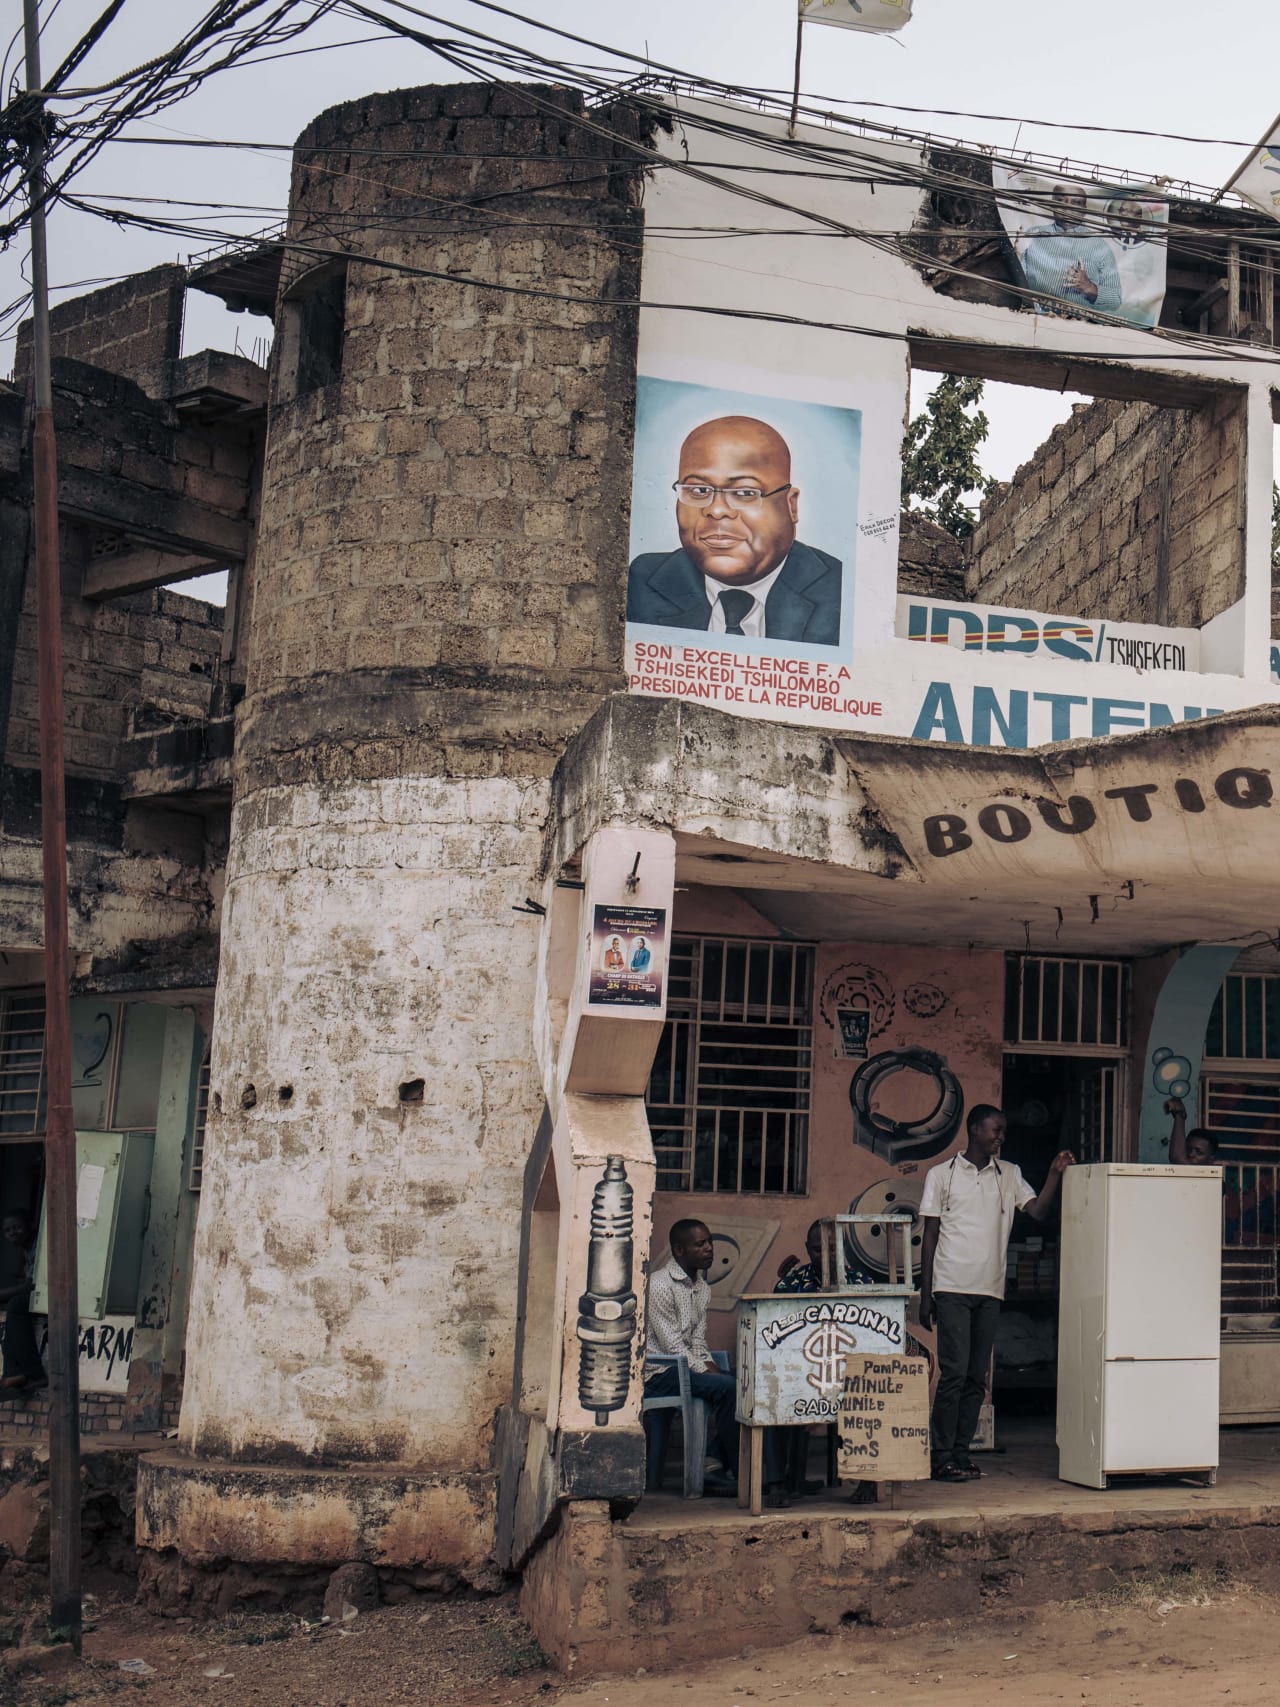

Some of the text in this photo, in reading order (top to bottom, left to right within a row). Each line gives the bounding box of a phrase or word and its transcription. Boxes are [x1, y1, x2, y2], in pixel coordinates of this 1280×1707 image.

[635, 642, 673, 661] SON
[683, 648, 810, 675] EXCELLENCE
[838, 665, 852, 680] A
[636, 658, 841, 695] TSHISEKEDI TSHILOMBO
[630, 674, 883, 718] PRESIDANT DE LA REPUBLIQUE
[805, 1303, 901, 1344] CARDINAL
